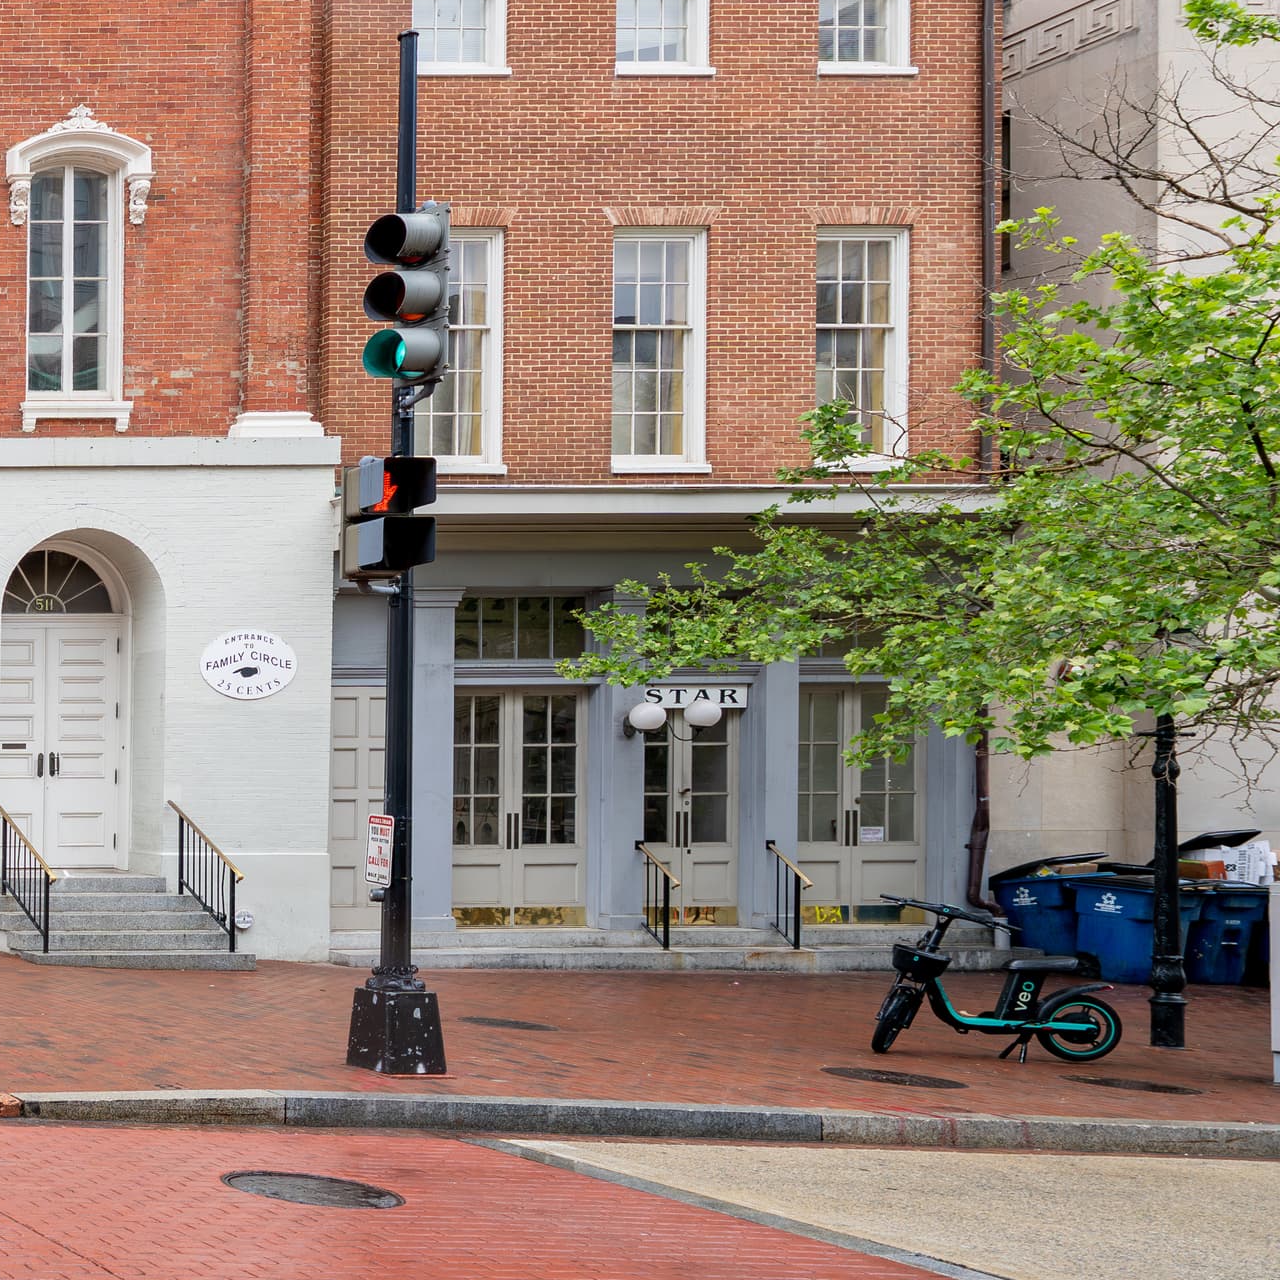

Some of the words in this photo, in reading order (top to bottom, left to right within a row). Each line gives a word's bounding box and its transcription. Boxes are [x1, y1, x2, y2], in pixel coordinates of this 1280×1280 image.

[35, 598, 54, 611] 511
[225, 634, 274, 645] ENTRANCE
[206, 651, 245, 671] FAMILY
[250, 651, 292, 669] CIRCLE
[217, 679, 232, 691] 25
[236, 678, 281, 695] CENTS
[645, 688, 738, 704] STAR
[371, 826, 379, 836] YOU
[379, 827, 390, 837] MUST
[377, 846, 382, 855] TO
[368, 856, 379, 867] CALL
[380, 858, 389, 868] FOR
[1014, 981, 1035, 1011] veo
